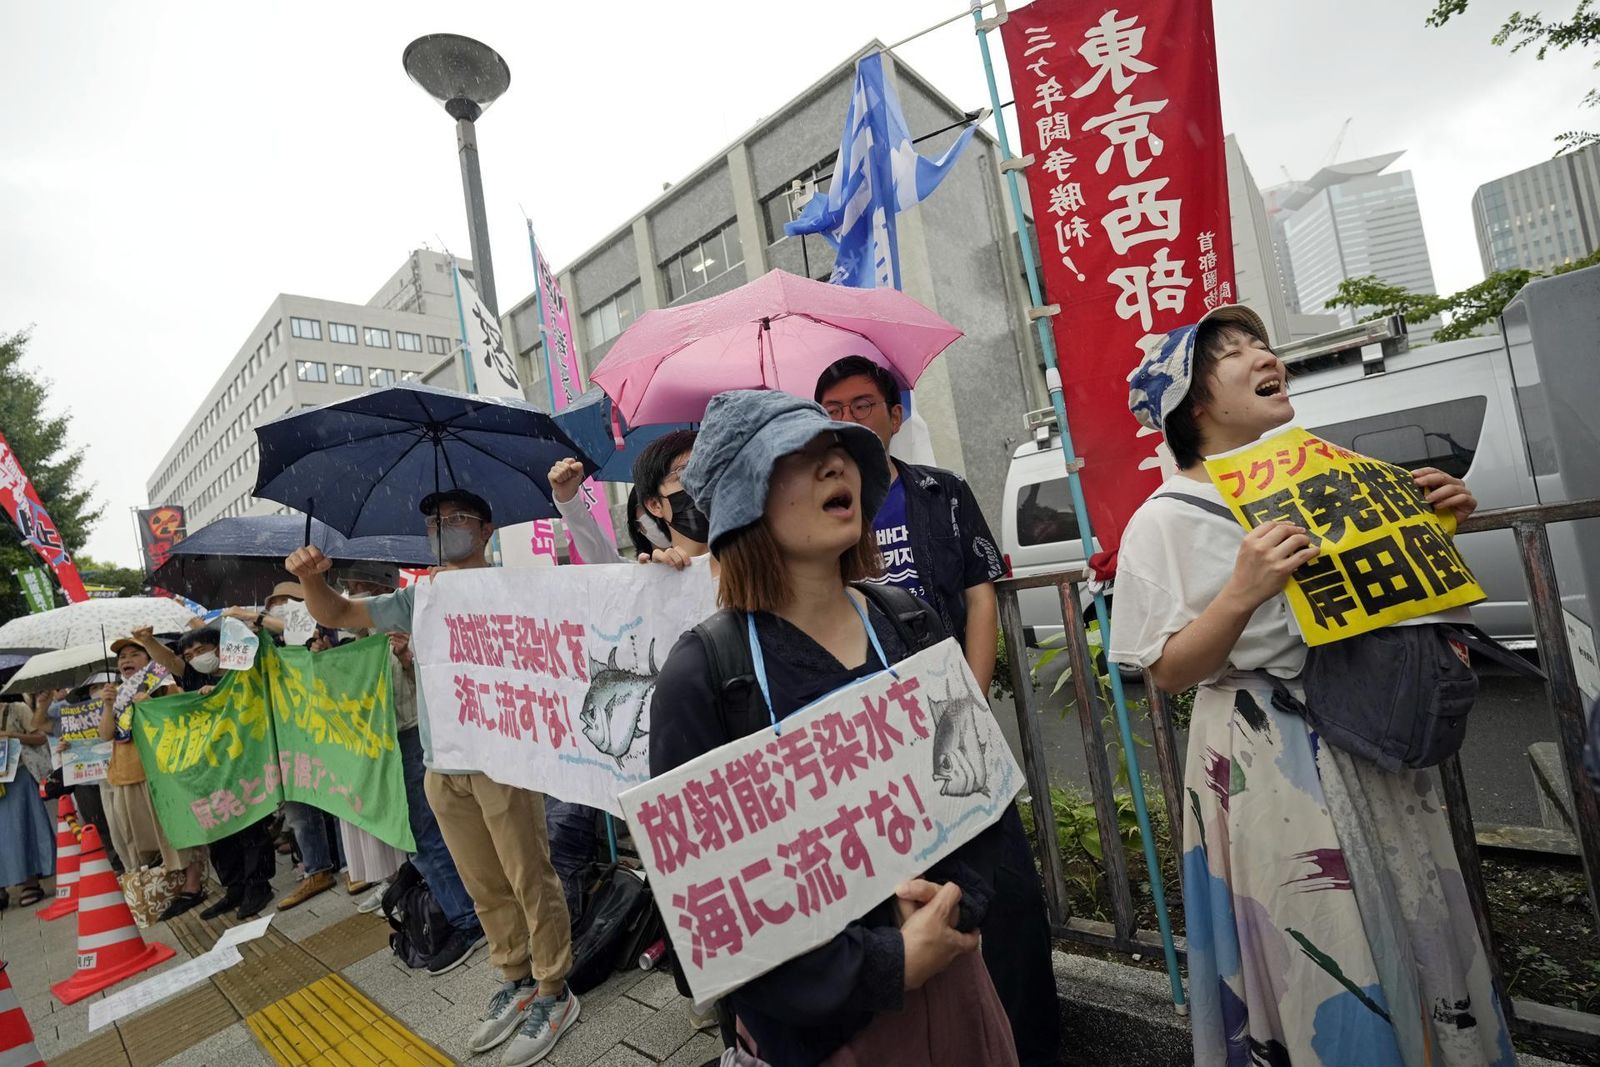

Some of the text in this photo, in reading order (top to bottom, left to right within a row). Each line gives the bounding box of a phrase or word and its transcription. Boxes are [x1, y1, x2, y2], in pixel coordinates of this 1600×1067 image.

[1219, 438, 1362, 498] フクシマ
[876, 525, 909, 546] 바다
[444, 613, 588, 684] 放射能汚染水を
[454, 673, 577, 750] 海に流すな!
[636, 676, 930, 876] 放射能汚染水を
[672, 773, 933, 970] 海に流すな!
